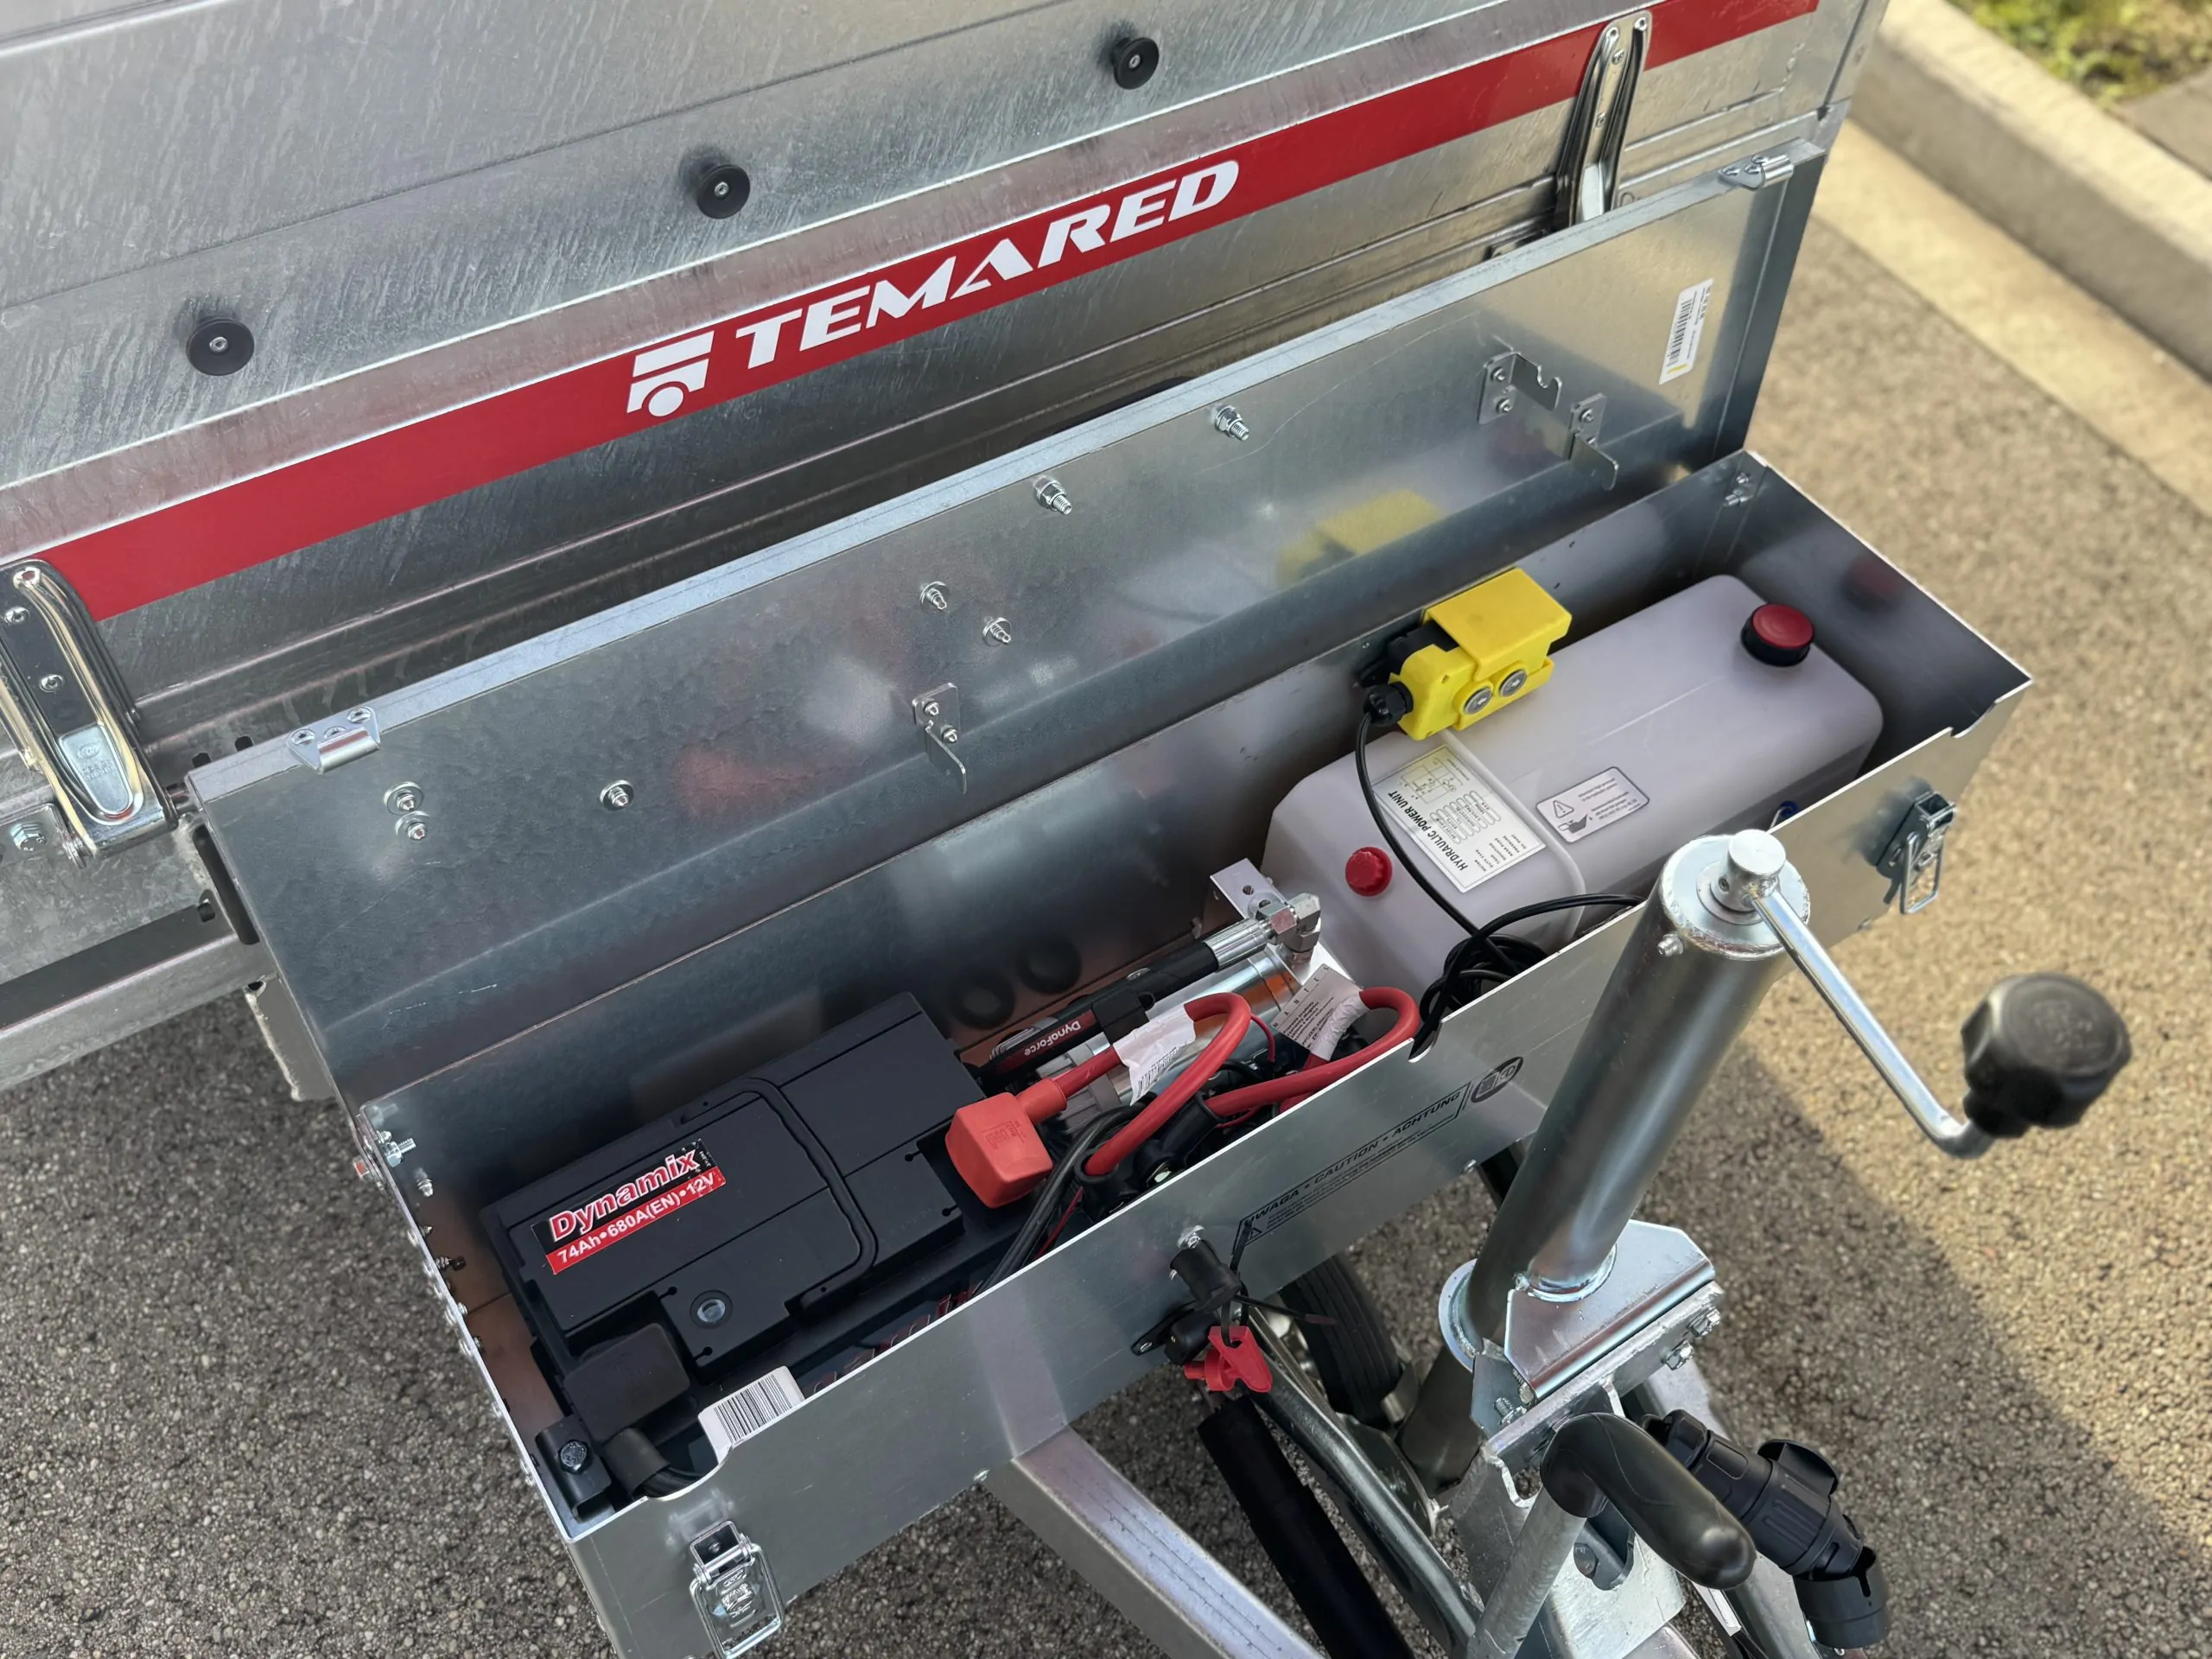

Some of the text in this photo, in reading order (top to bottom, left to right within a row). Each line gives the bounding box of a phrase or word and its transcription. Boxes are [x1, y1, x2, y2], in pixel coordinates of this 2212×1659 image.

[735, 160, 1240, 370] TEMARED
[1388, 789, 1408, 808] UNIT
[1403, 805, 1431, 831] POWER
[1426, 830, 1468, 870] HYDRAULIC
[1024, 1020, 1081, 1056] DynaForce
[1314, 1141, 1379, 1185] CAUTION
[1391, 1091, 1461, 1139] ACHTUNG
[550, 1148, 701, 1243] Dynamix
